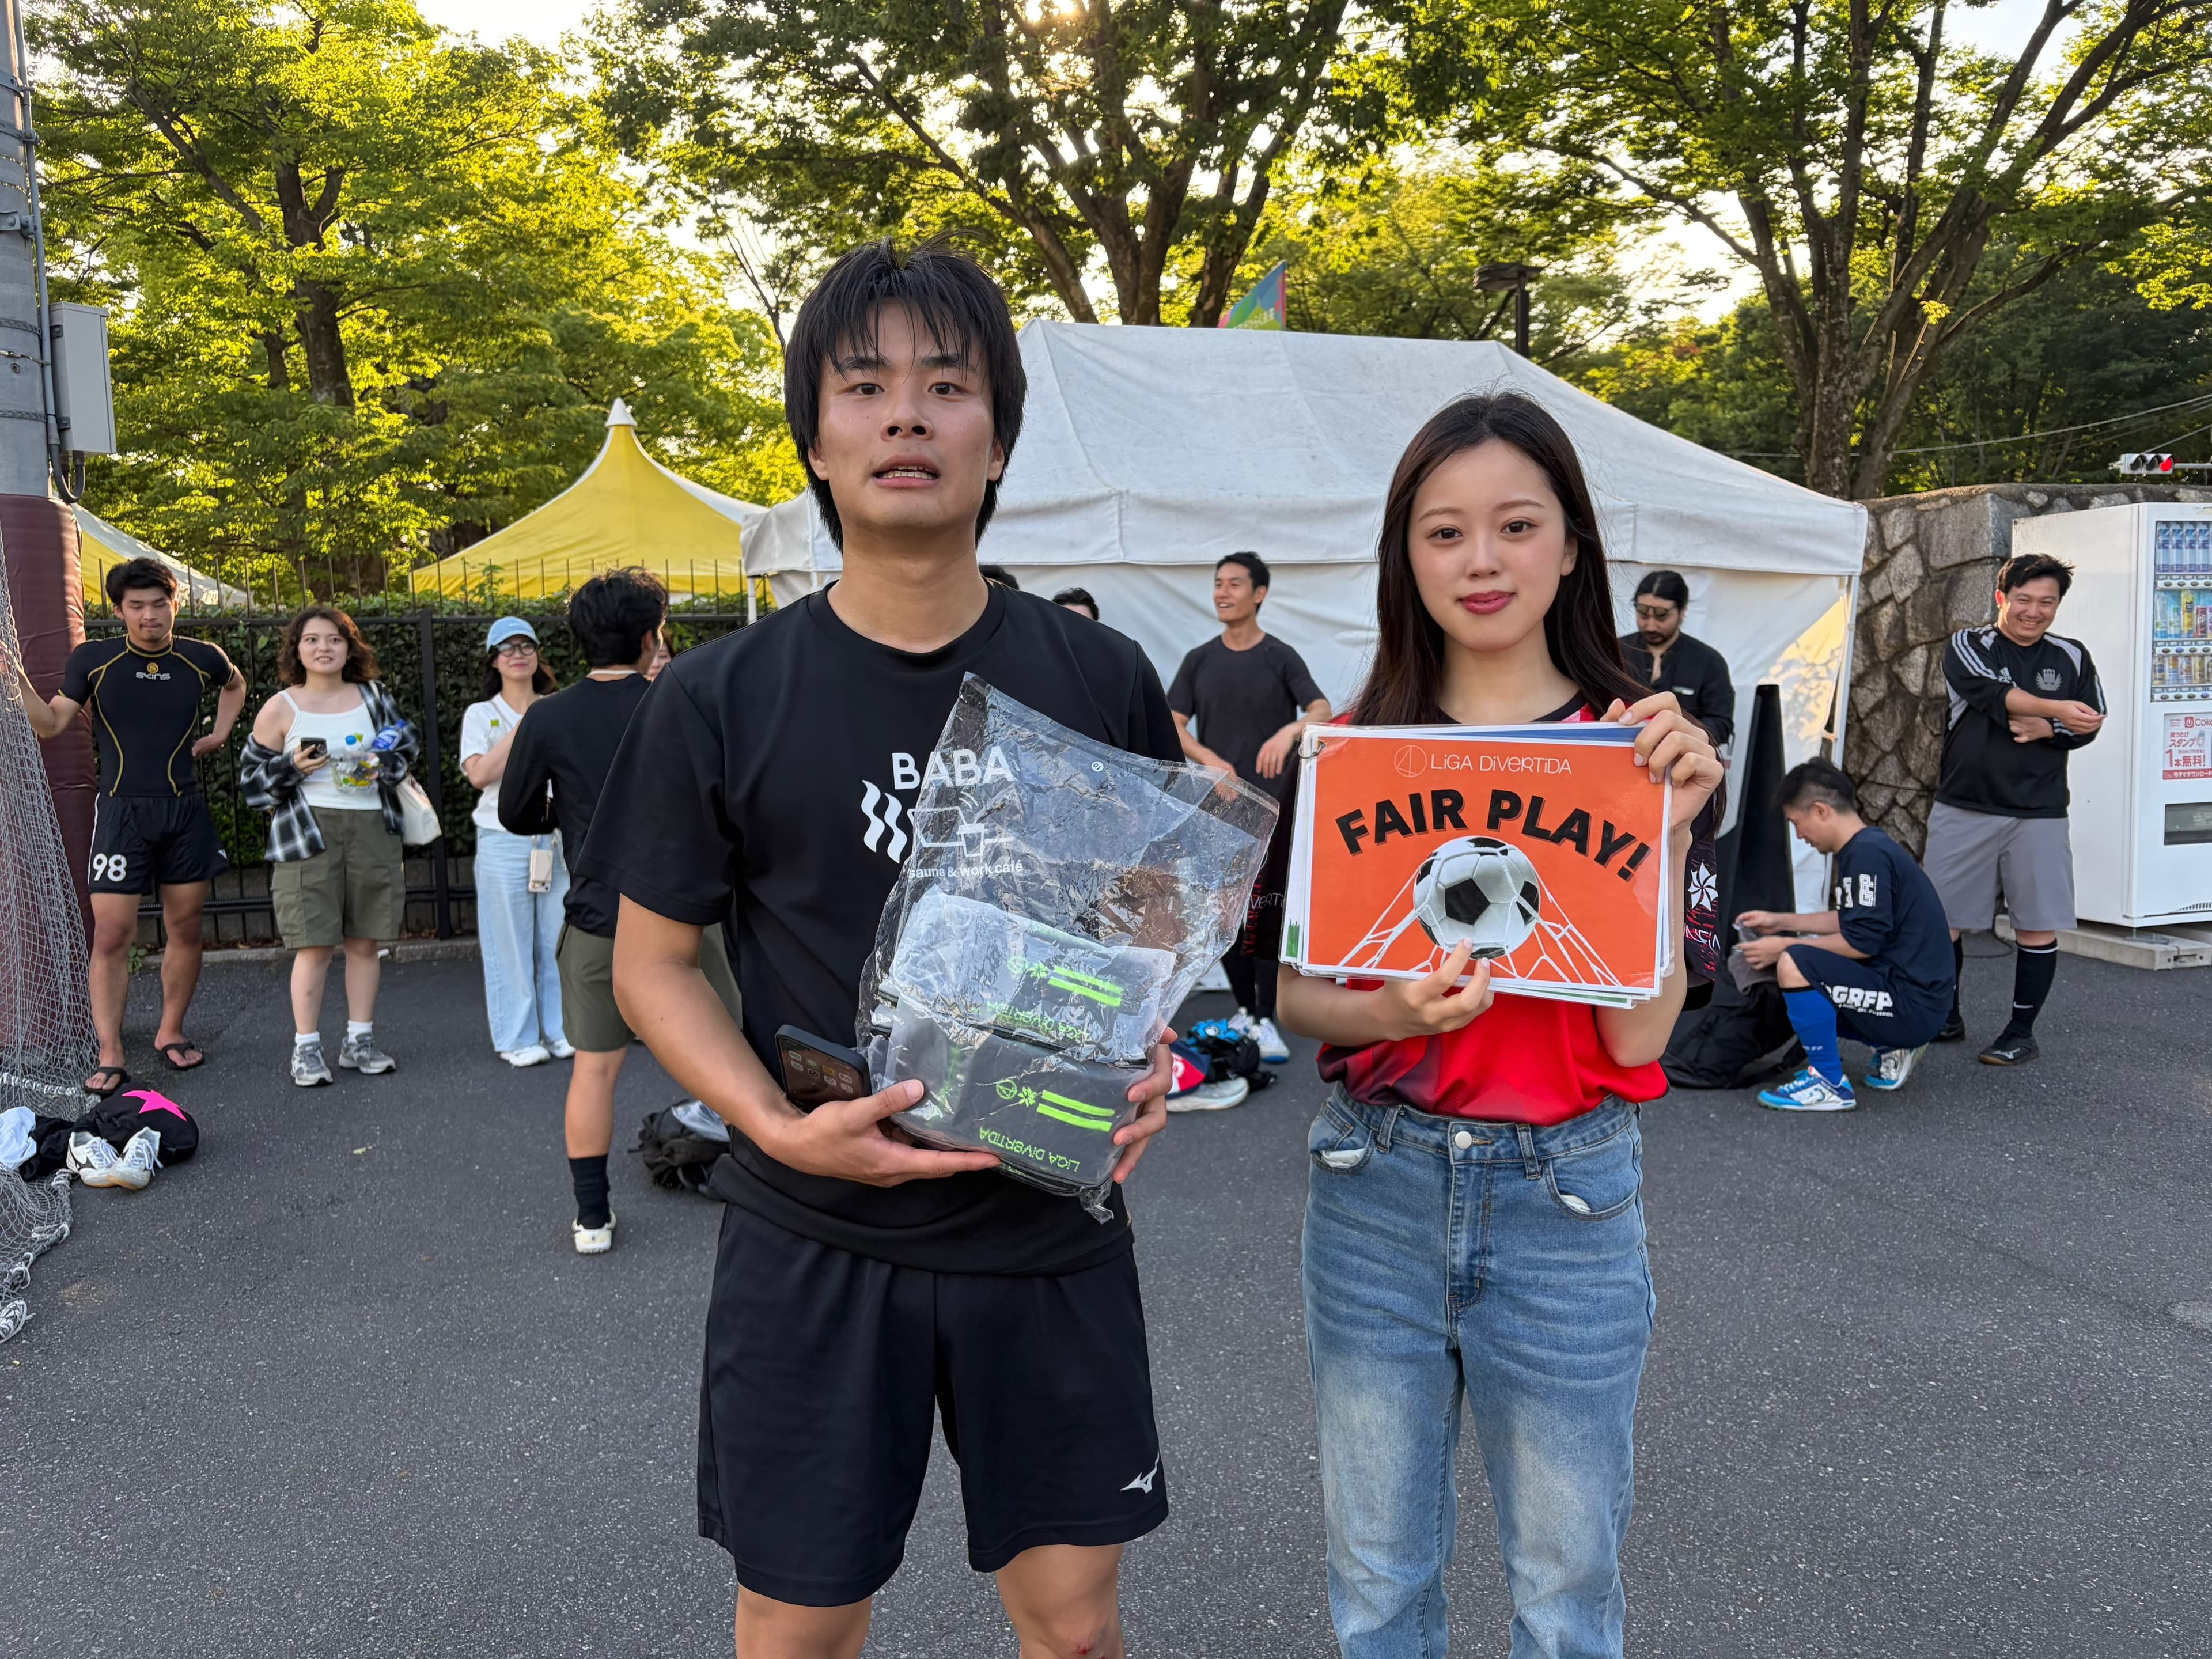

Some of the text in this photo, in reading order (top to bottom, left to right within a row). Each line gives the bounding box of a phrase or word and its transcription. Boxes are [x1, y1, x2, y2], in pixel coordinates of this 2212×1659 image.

[2169, 737, 2196, 747] スタンプ
[892, 746, 1017, 790] BABA
[1335, 789, 1652, 882] FAIR PLAY!
[93, 853, 127, 882] 98
[908, 859, 1024, 878] sauna & work café
